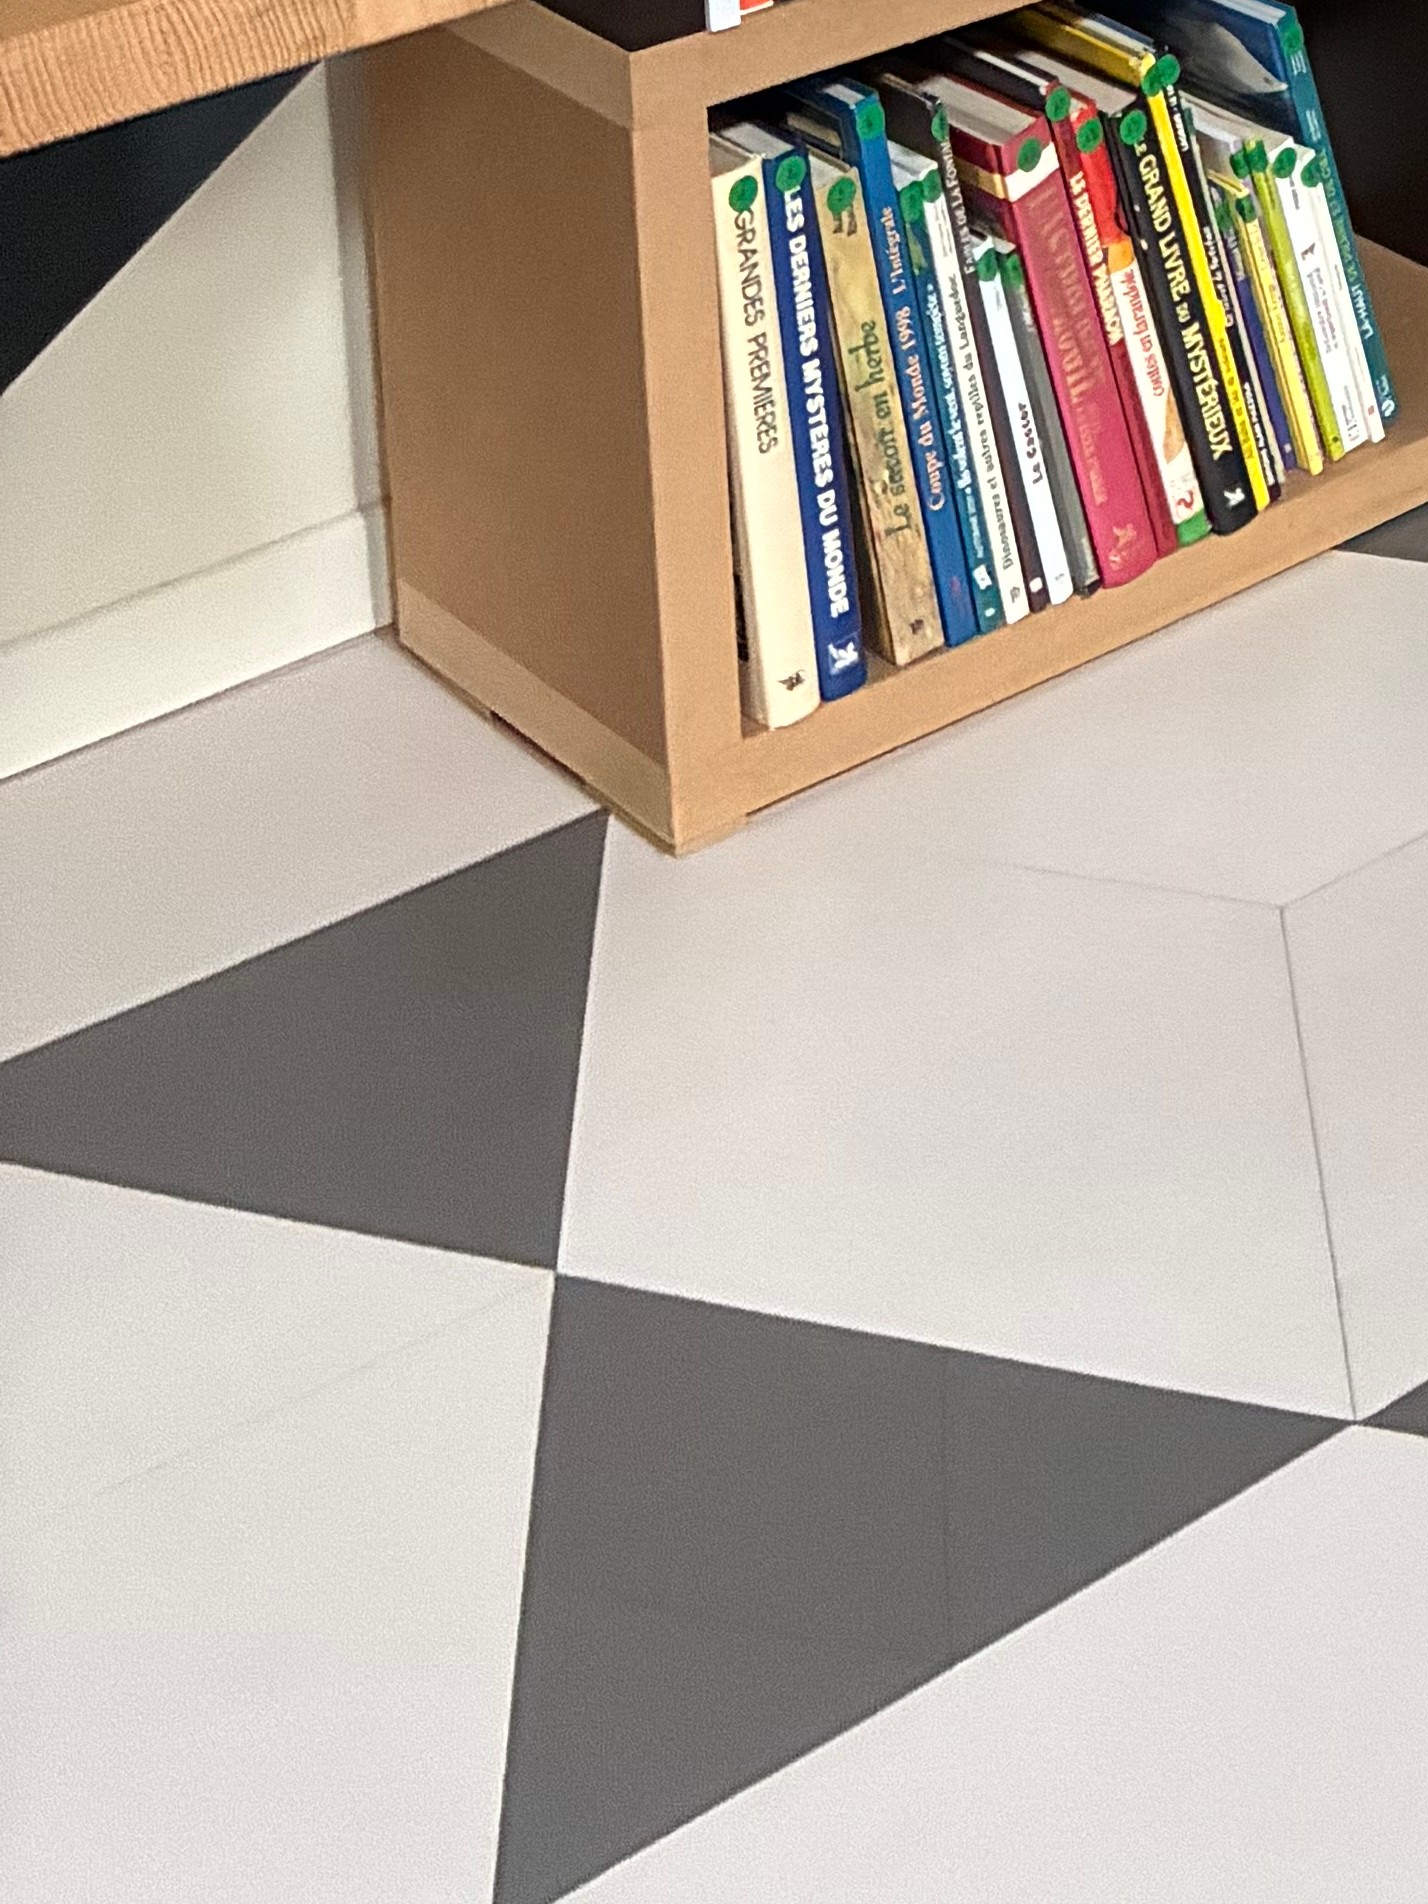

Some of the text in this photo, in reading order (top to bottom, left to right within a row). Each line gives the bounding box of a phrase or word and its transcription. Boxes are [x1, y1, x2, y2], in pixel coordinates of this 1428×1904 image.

[733, 209, 768, 328] GRANDES
[1075, 190, 1104, 264] DERNIER
[947, 272, 972, 350] Languedoc
[1121, 268, 1165, 398] contes en farandole
[1136, 153, 1234, 461] GRAND LIVRE MYSTÉRIEUX
[782, 185, 852, 618] LES DERNIERS DU MONDE
[881, 206, 946, 513] Coupe du Monde 1998 L'Intégrale
[958, 351, 975, 371] du
[848, 319, 913, 537] Le en herbe
[978, 428, 996, 471] autres
[1017, 401, 1039, 459] Castor
[990, 492, 1014, 570] Dinosaures
